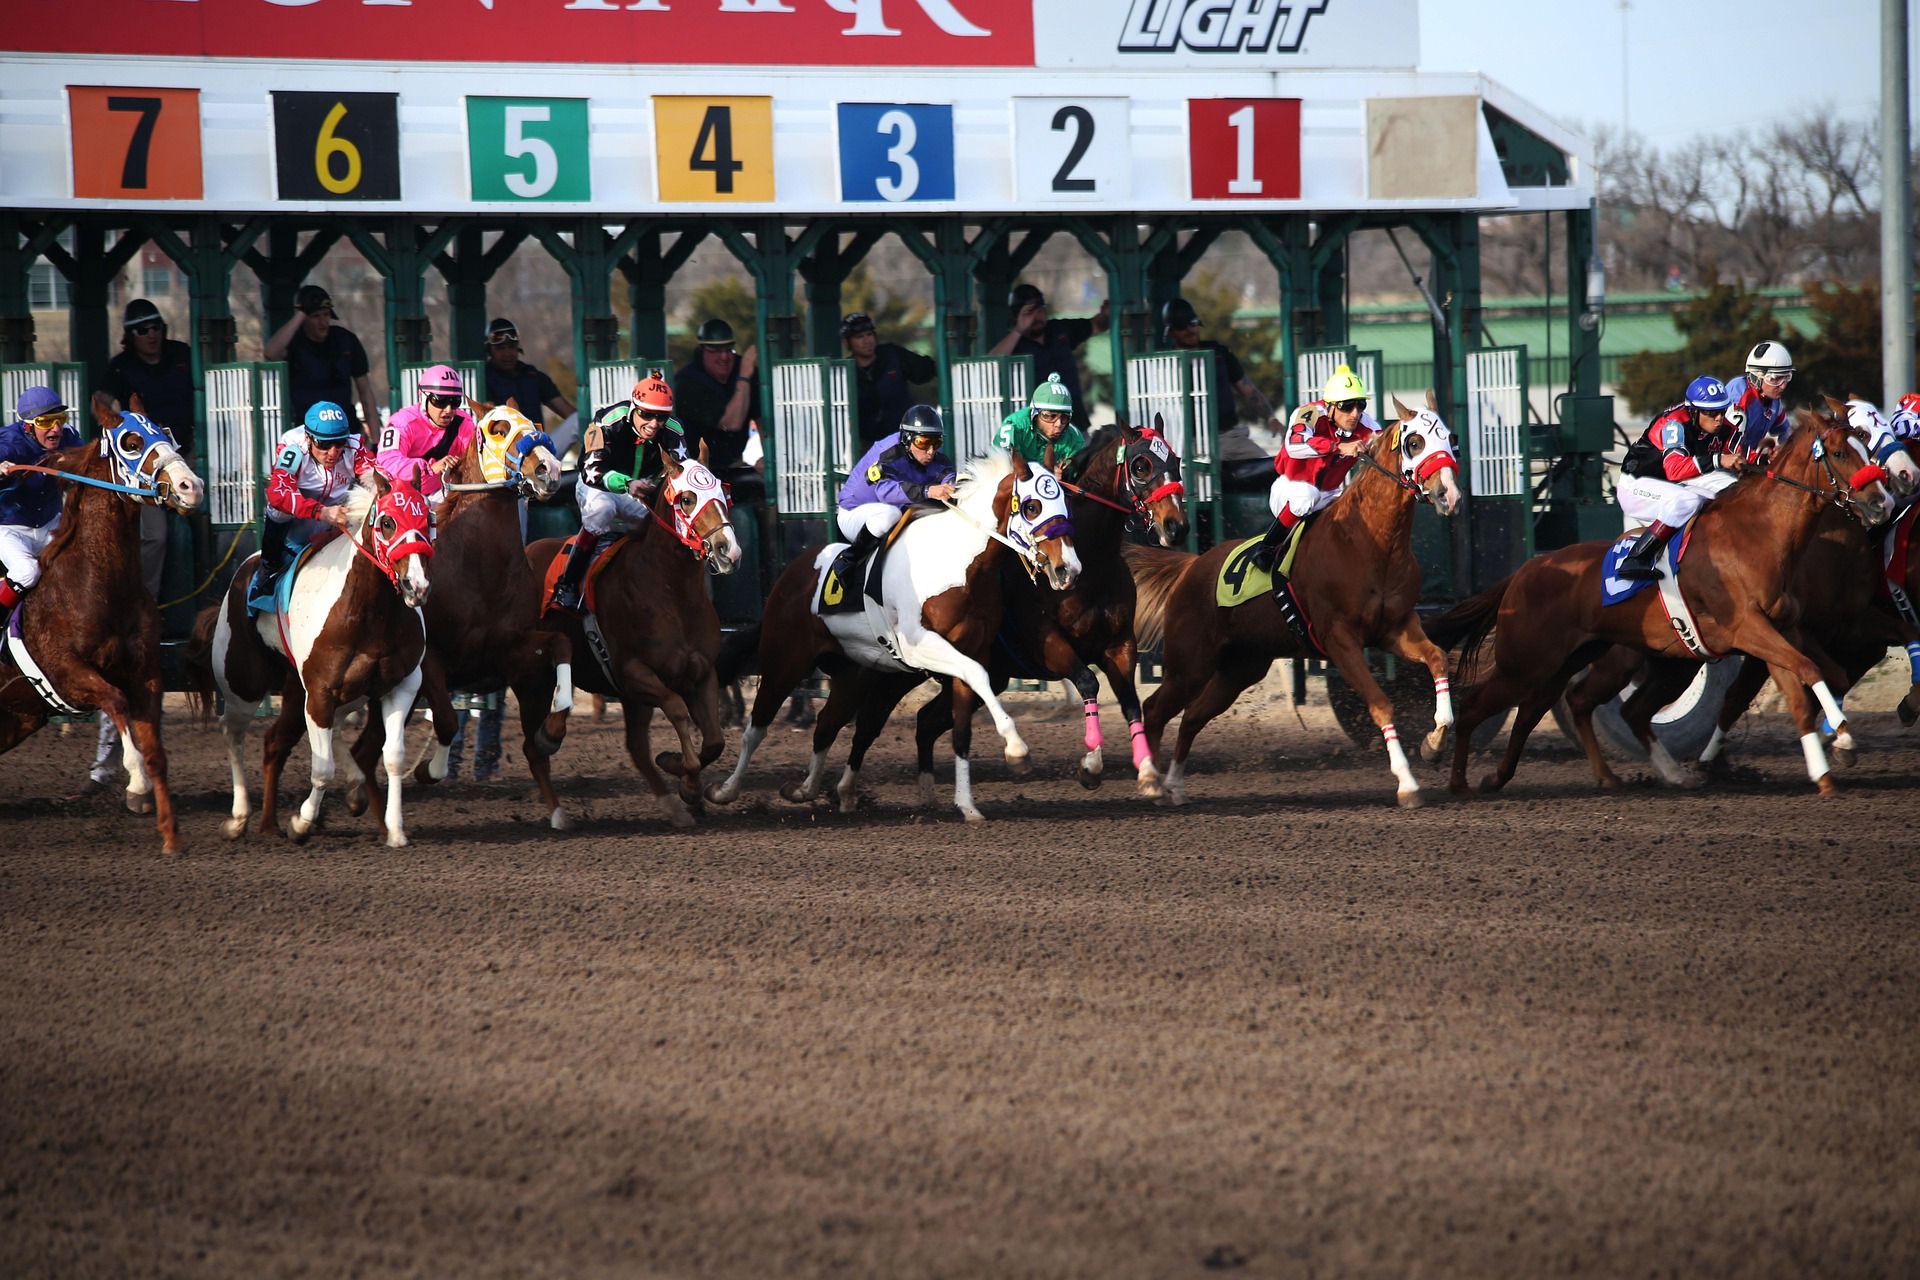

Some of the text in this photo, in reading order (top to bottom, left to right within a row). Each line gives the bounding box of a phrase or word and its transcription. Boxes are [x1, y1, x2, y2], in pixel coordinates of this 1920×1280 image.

[1118, 0, 1330, 54] LIGHT
[106, 96, 162, 189] 7
[315, 102, 362, 194] 6
[503, 106, 558, 198] 5
[689, 106, 743, 193] 4
[1050, 105, 1097, 192] 2
[1227, 106, 1264, 194] 1
[875, 110, 920, 202] 3
[649, 383, 668, 395] JRS
[319, 409, 343, 421] GRC
[1301, 410, 1313, 422] 4
[382, 429, 395, 448] 8
[588, 430, 597, 447] 7
[999, 425, 1012, 448] 5
[1666, 426, 1679, 444] 3
[100, 438, 109, 457] 10
[1812, 441, 1823, 457] 3
[280, 450, 297, 469] 9
[1011, 496, 1019, 513] 6
[1223, 541, 1262, 597] 4
